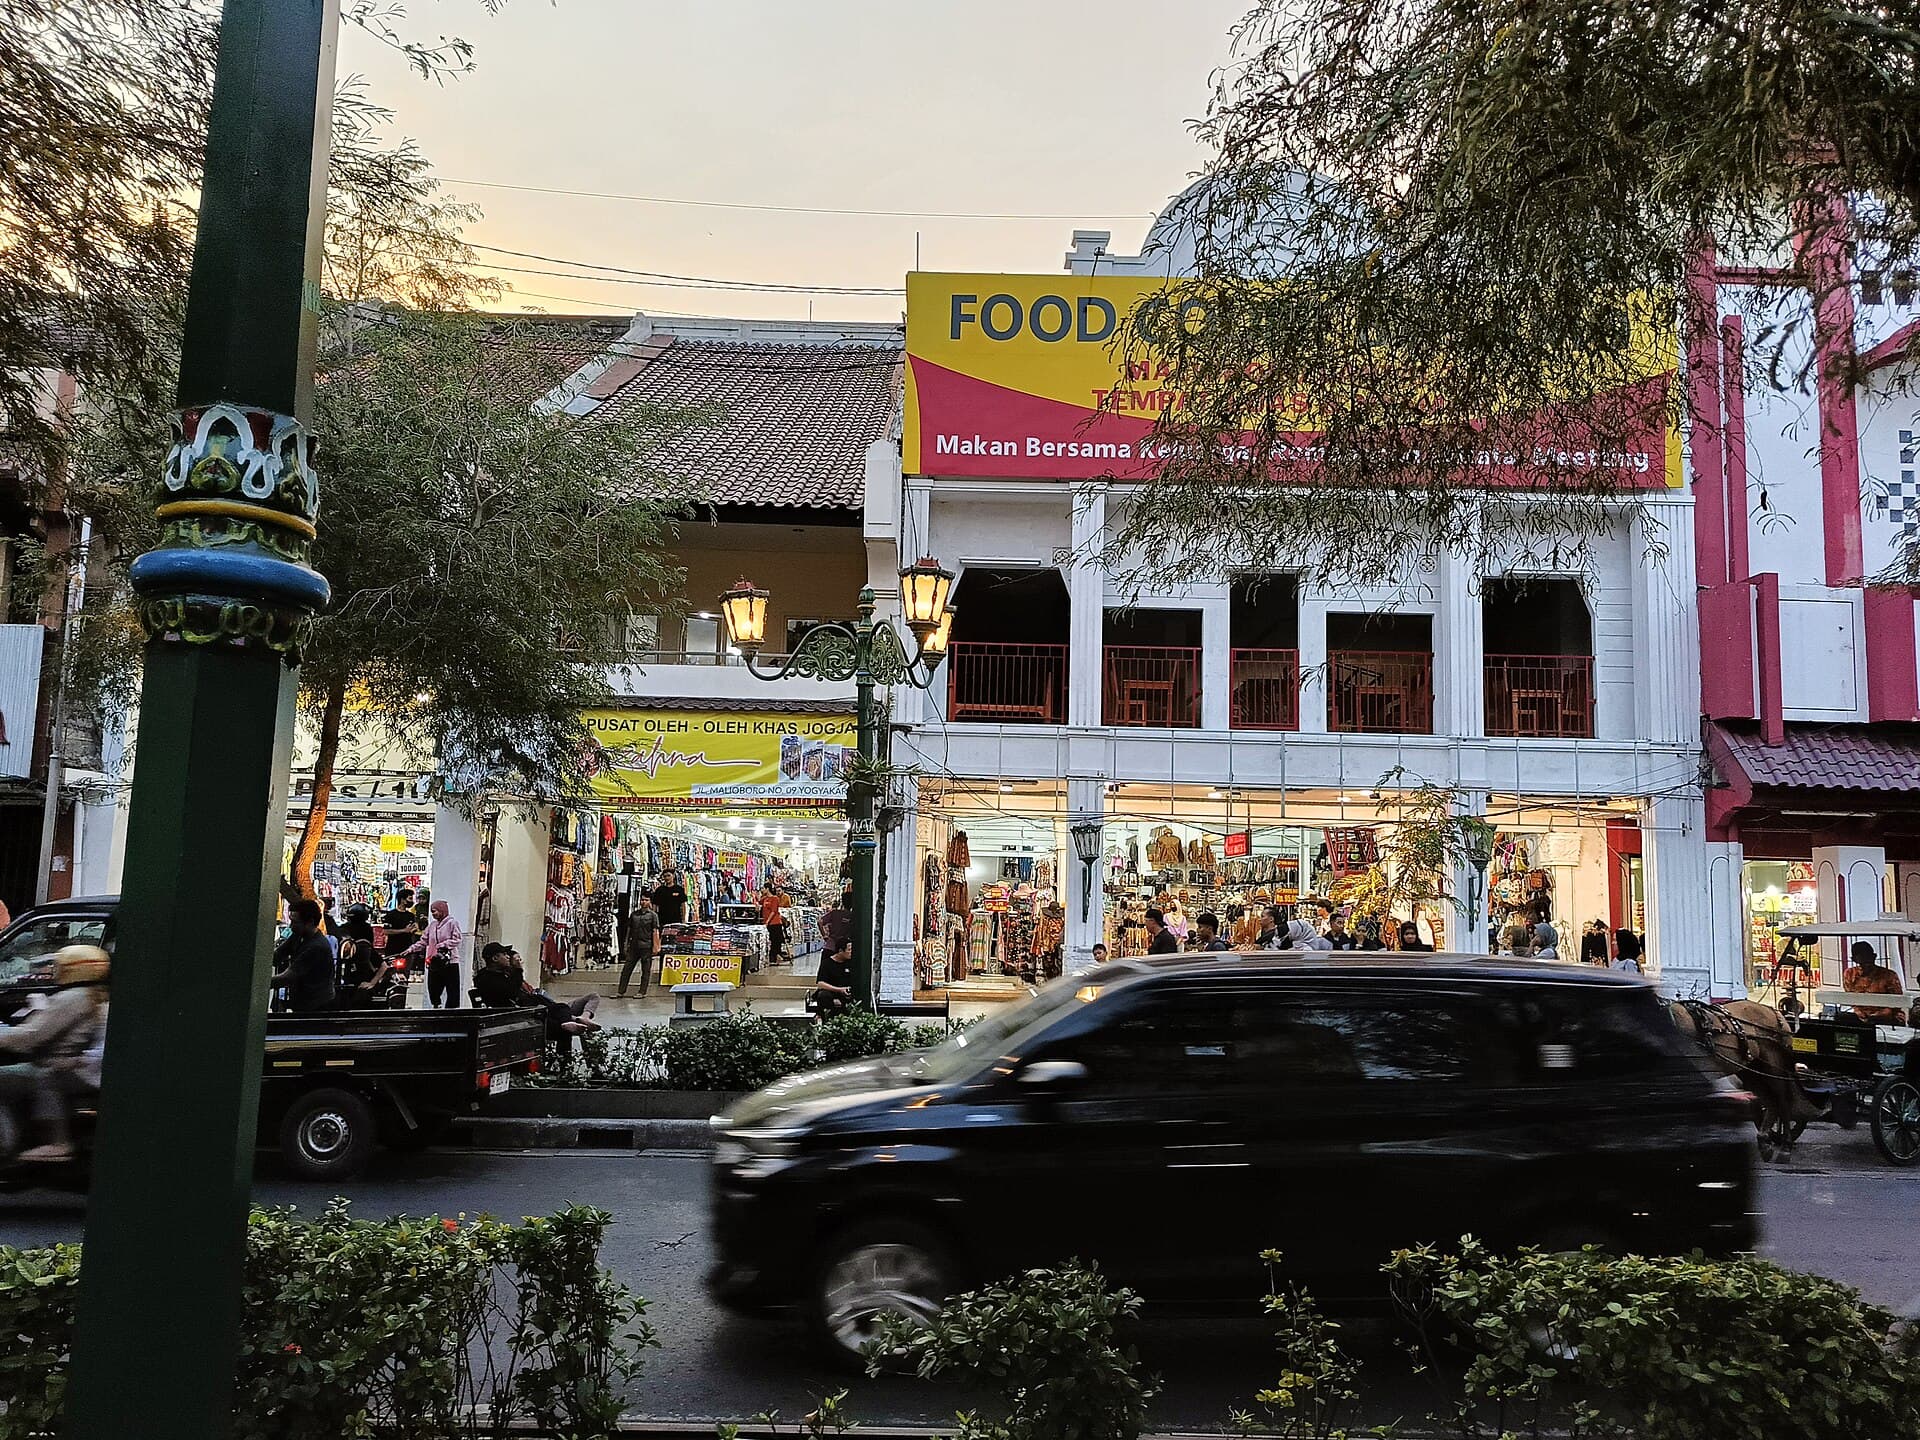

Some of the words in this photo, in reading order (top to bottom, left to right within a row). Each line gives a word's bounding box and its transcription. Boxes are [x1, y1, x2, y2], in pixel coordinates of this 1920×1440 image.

[950, 294, 1116, 342] FOOD
[936, 434, 1017, 455] Makan
[1026, 437, 1131, 459] Bersama
[586, 719, 639, 732] PUSAT
[644, 720, 688, 733] OLEH
[703, 721, 747, 734] OLEH
[753, 722, 797, 735] KHAS
[802, 722, 857, 735] JOGJA
[707, 786, 765, 795] MALIOBORO
[786, 787, 796, 795] 09
[799, 786, 847, 795] YOGYAKAR
[400, 864, 426, 872] 100.000
[665, 957, 681, 970] Rp
[682, 972, 689, 983] 7
[692, 973, 718, 983] PCS
